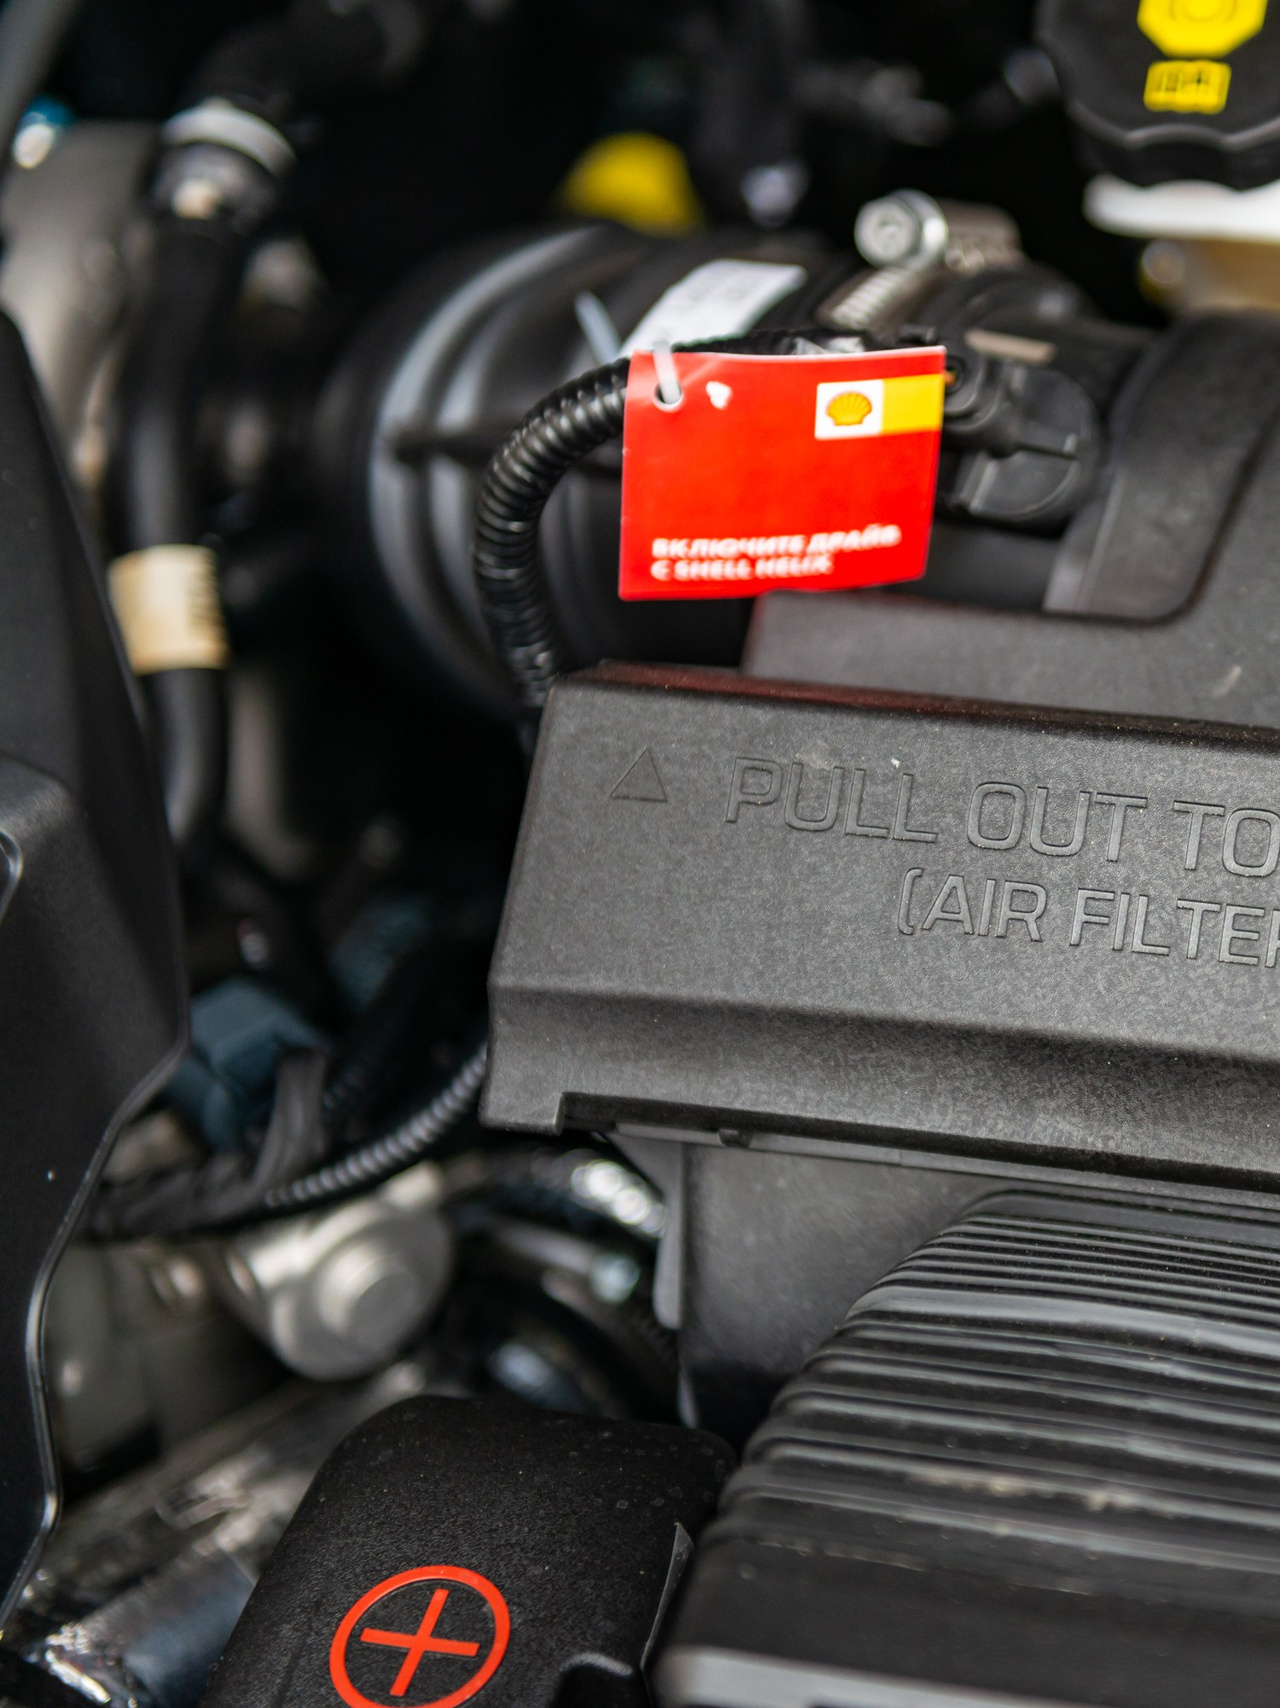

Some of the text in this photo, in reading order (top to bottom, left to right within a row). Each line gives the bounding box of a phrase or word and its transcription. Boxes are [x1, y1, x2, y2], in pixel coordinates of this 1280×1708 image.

[674, 559, 753, 580] SHELL
[725, 757, 938, 843] PULL
[967, 781, 1148, 862] OUT
[898, 867, 1047, 942] (AIR
